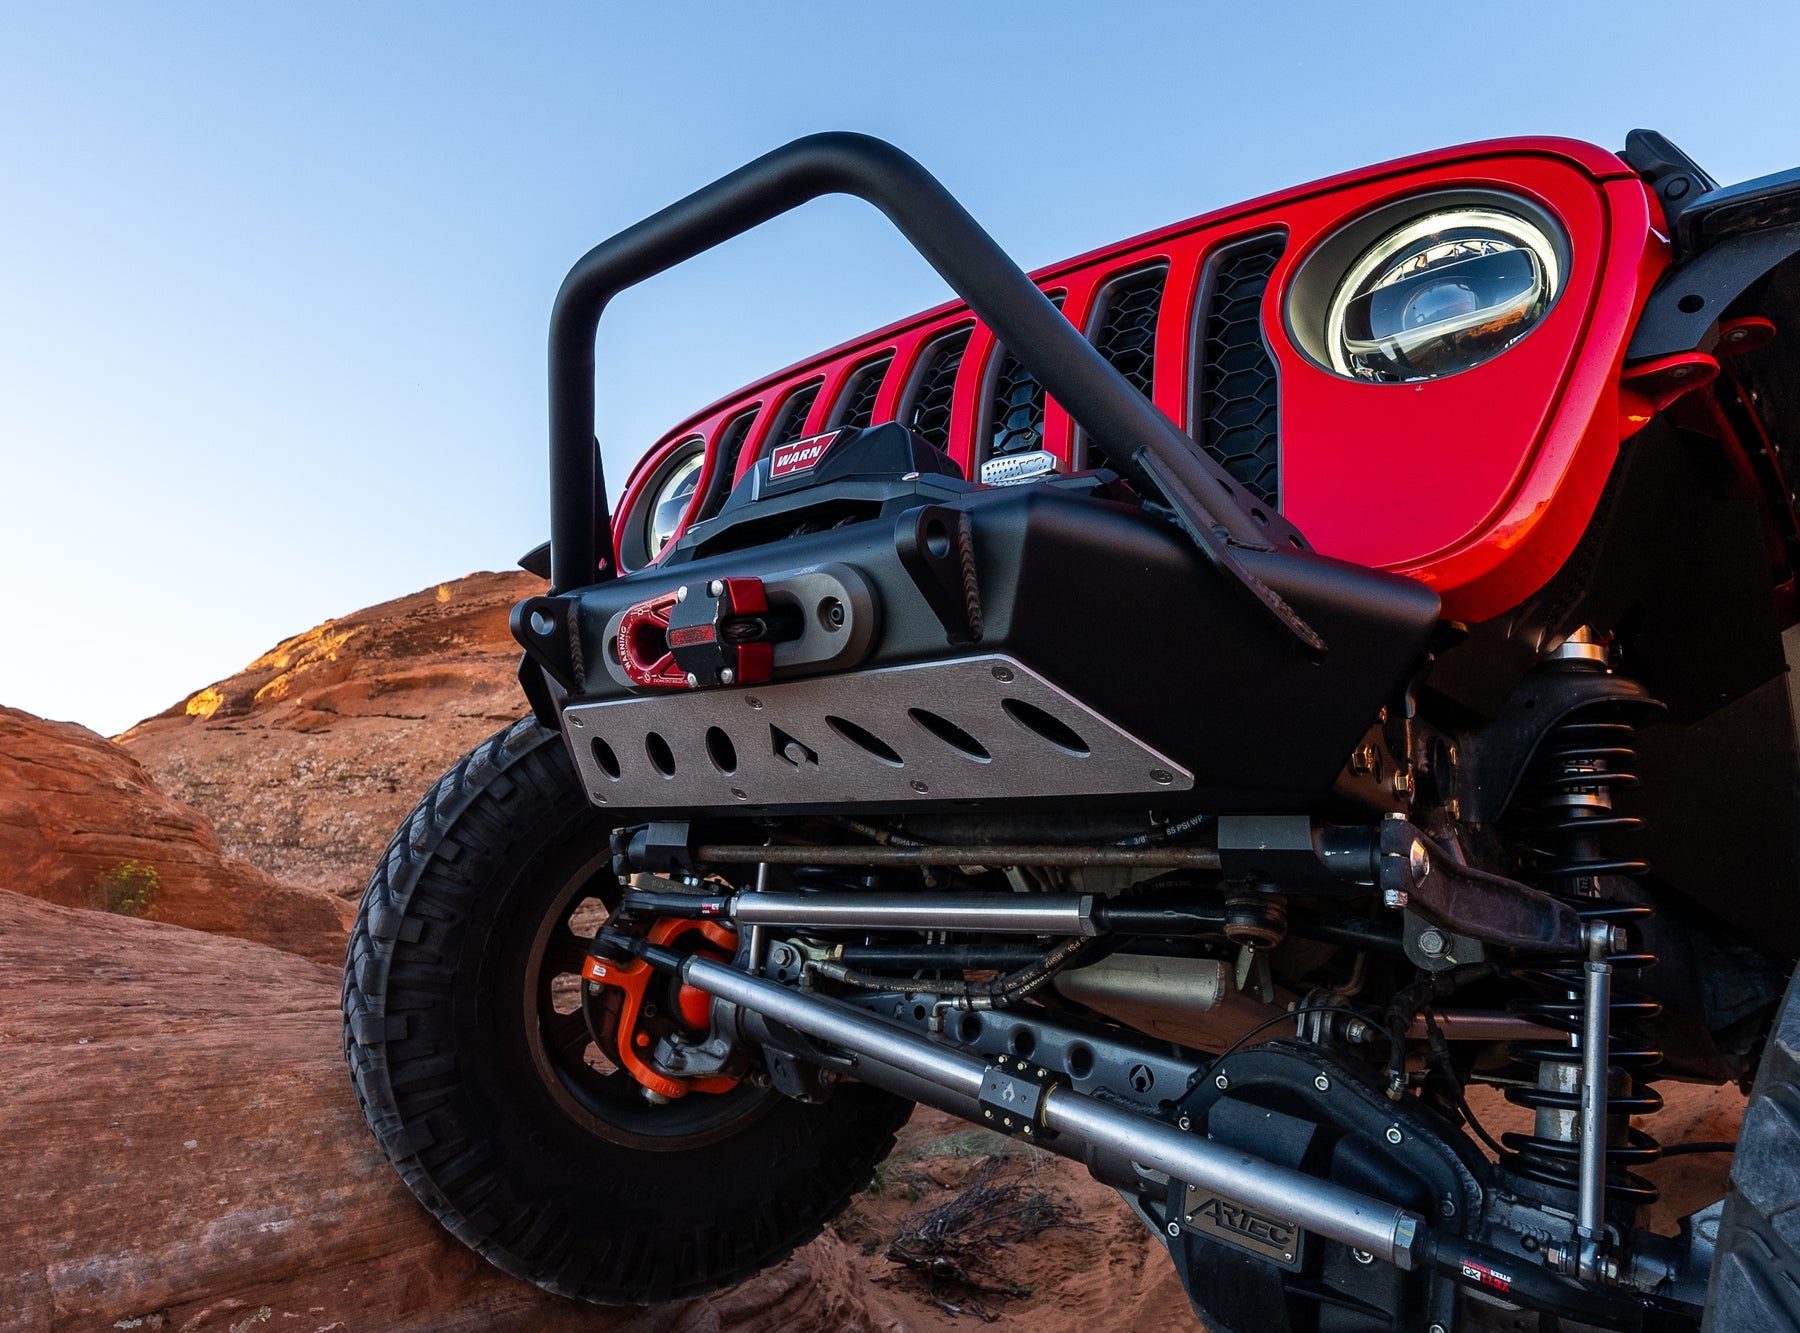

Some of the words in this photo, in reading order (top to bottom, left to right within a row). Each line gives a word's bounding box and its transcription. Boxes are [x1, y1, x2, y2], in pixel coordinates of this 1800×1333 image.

[776, 444, 823, 468] WARN
[618, 625, 631, 671] WARNING
[1176, 819, 1191, 832] PSI
[1190, 813, 1203, 826] WP
[1066, 939, 1081, 953] PSI
[1187, 1197, 1295, 1251] ARTEC
